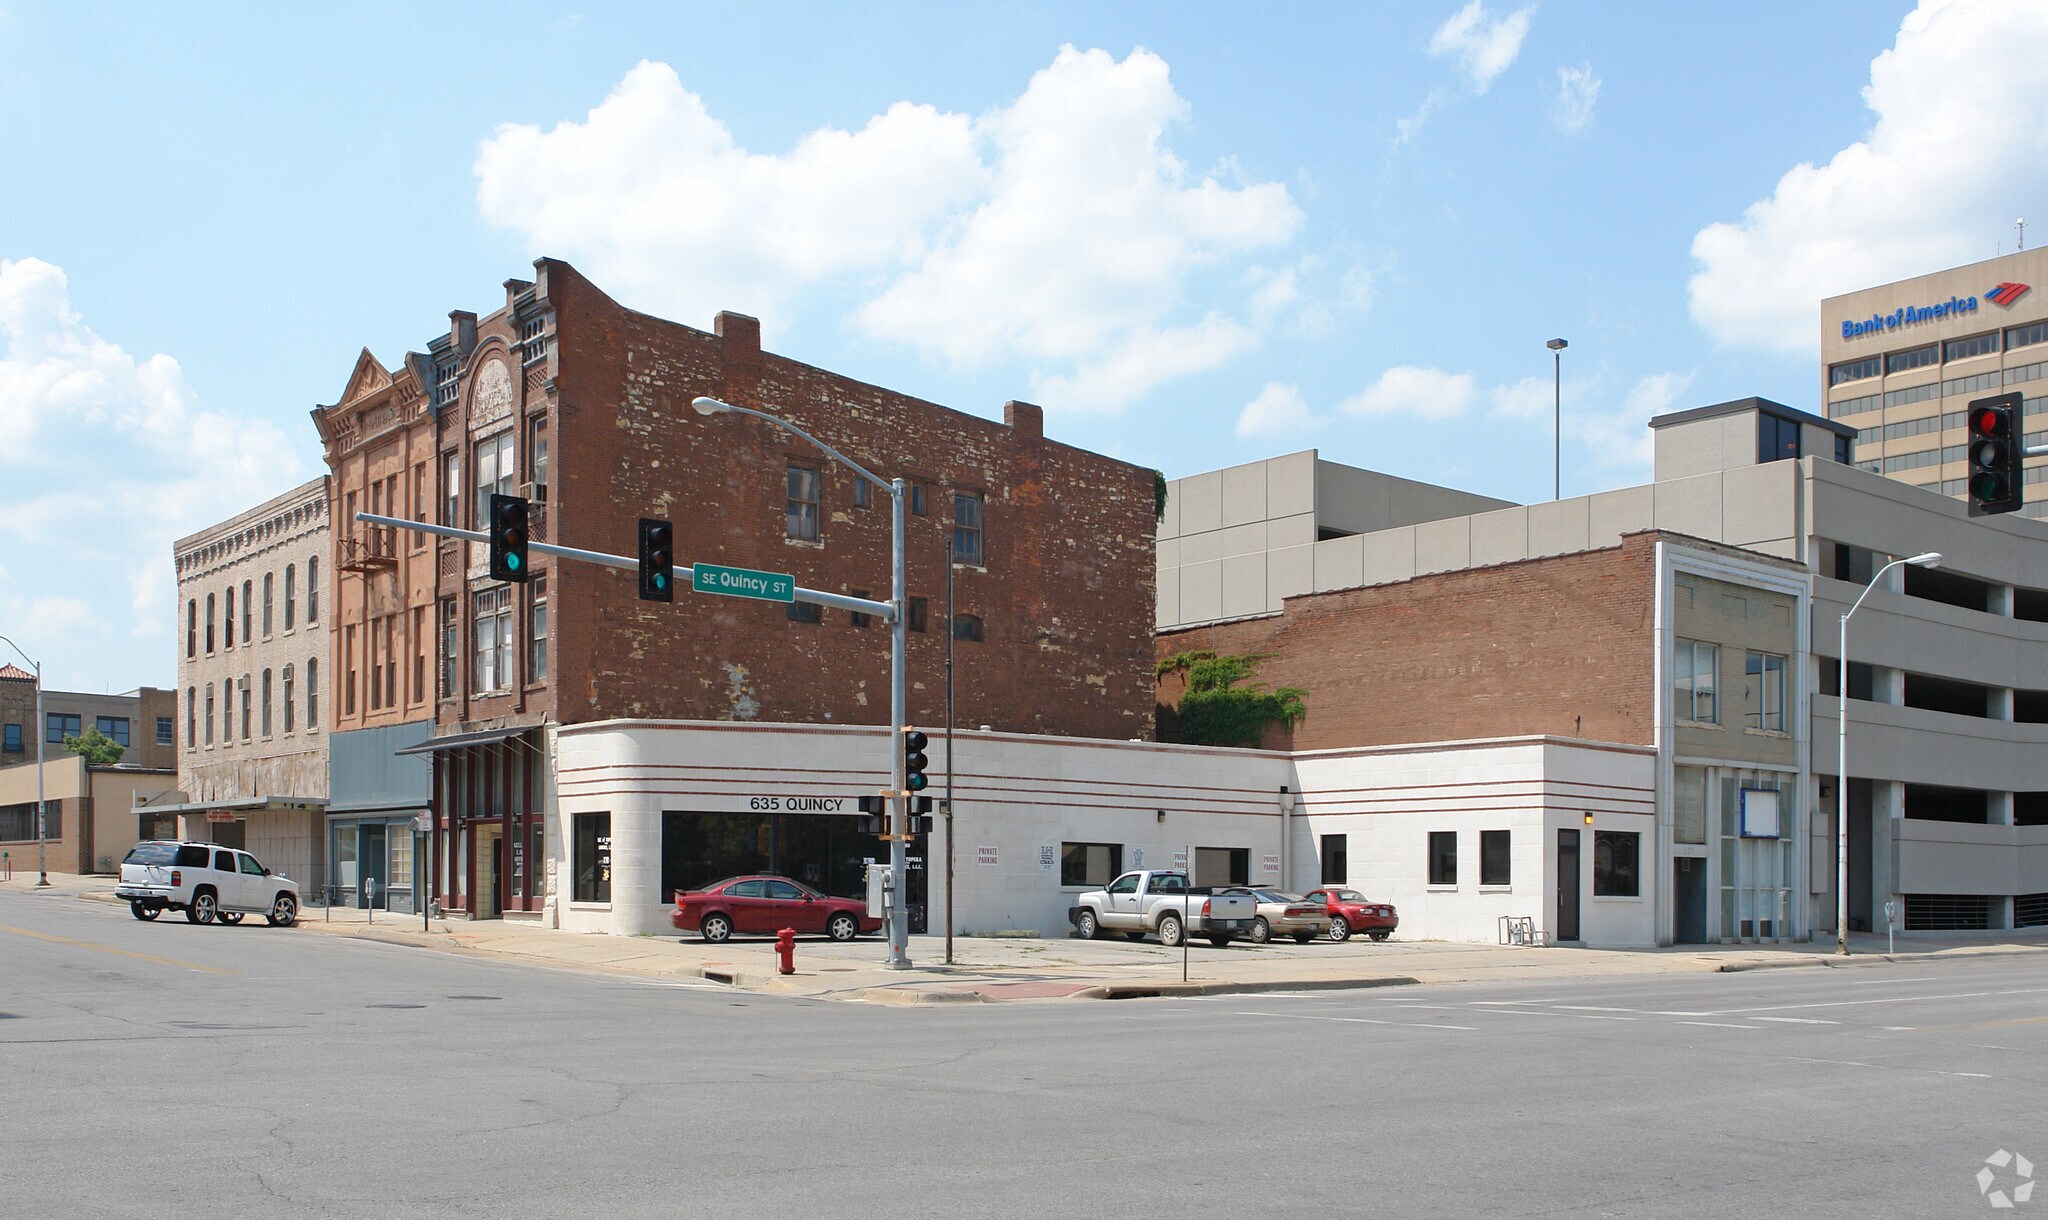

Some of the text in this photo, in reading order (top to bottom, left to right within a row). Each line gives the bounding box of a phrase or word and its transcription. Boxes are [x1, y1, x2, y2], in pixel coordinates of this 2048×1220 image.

[1841, 295, 1978, 338] Bank of America
[702, 572, 787, 594] SE Quincy ST
[750, 797, 843, 812] 635 QUINCY
[978, 847, 998, 856] PRIVATE
[978, 856, 998, 865] PARKING
